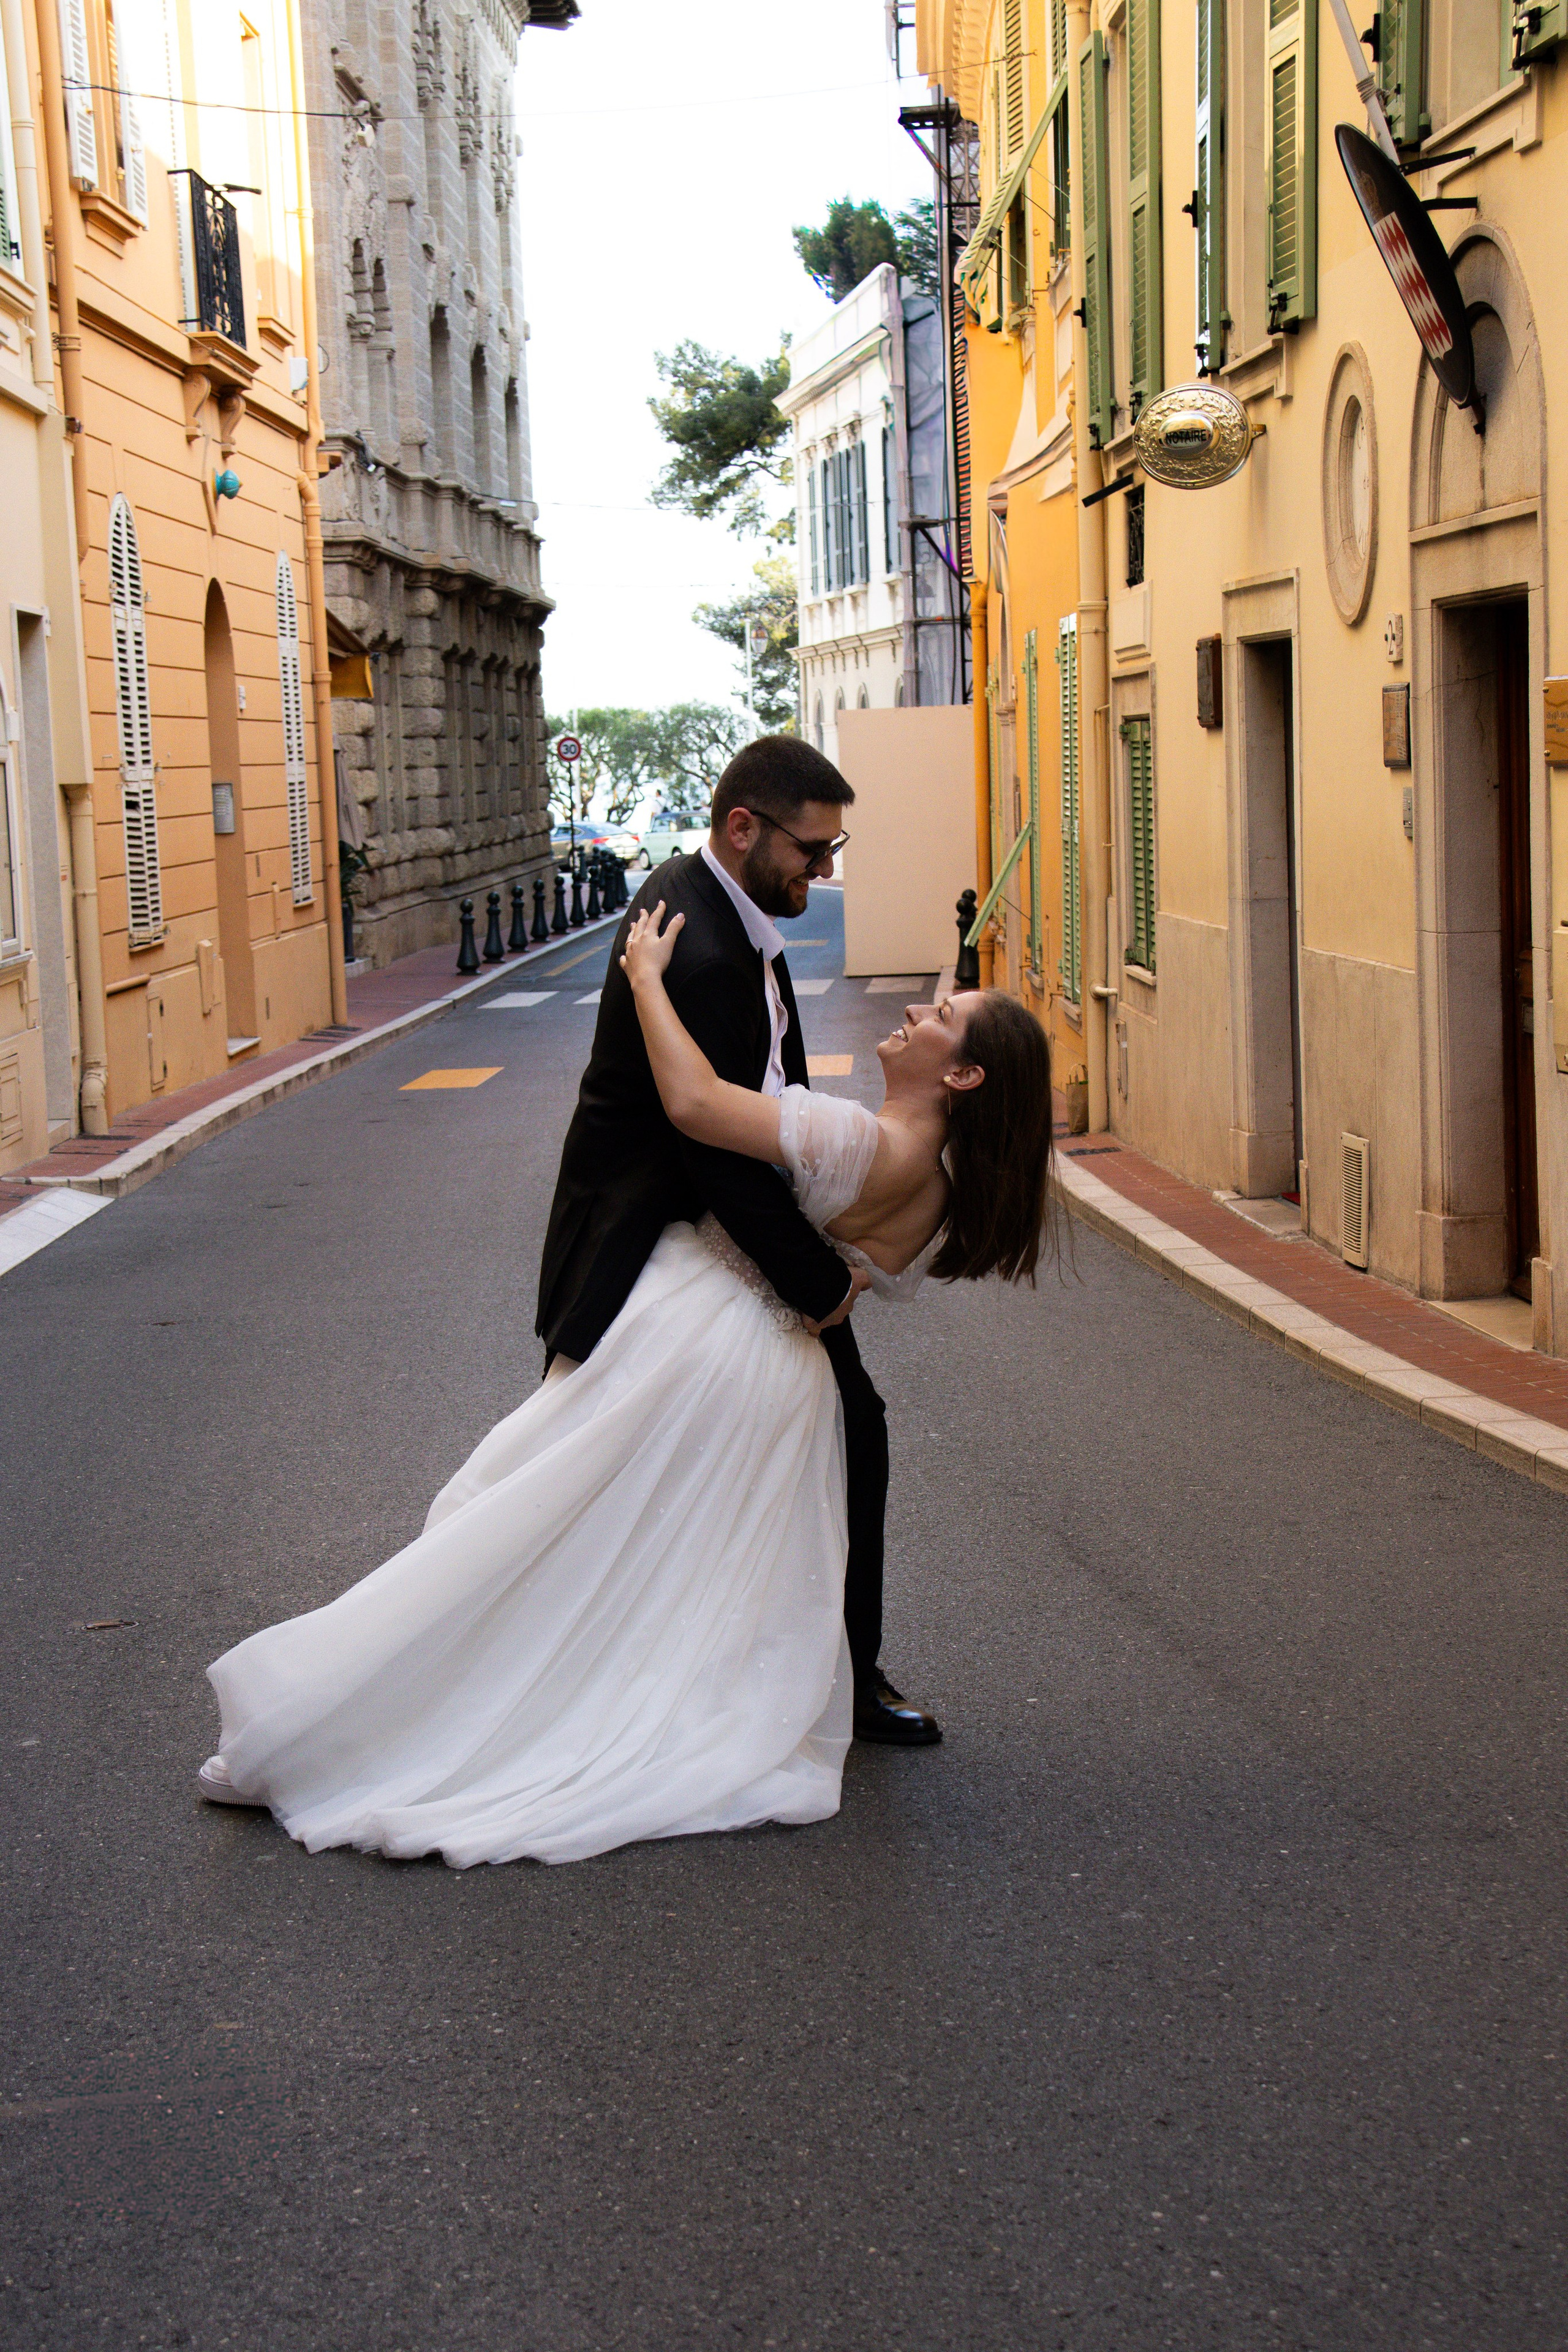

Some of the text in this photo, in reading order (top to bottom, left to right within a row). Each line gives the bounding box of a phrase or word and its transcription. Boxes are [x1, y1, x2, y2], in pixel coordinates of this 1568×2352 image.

[1166, 429, 1207, 444] NOTAIRE
[1388, 620, 1393, 655] 2
[563, 744, 577, 755] 30
